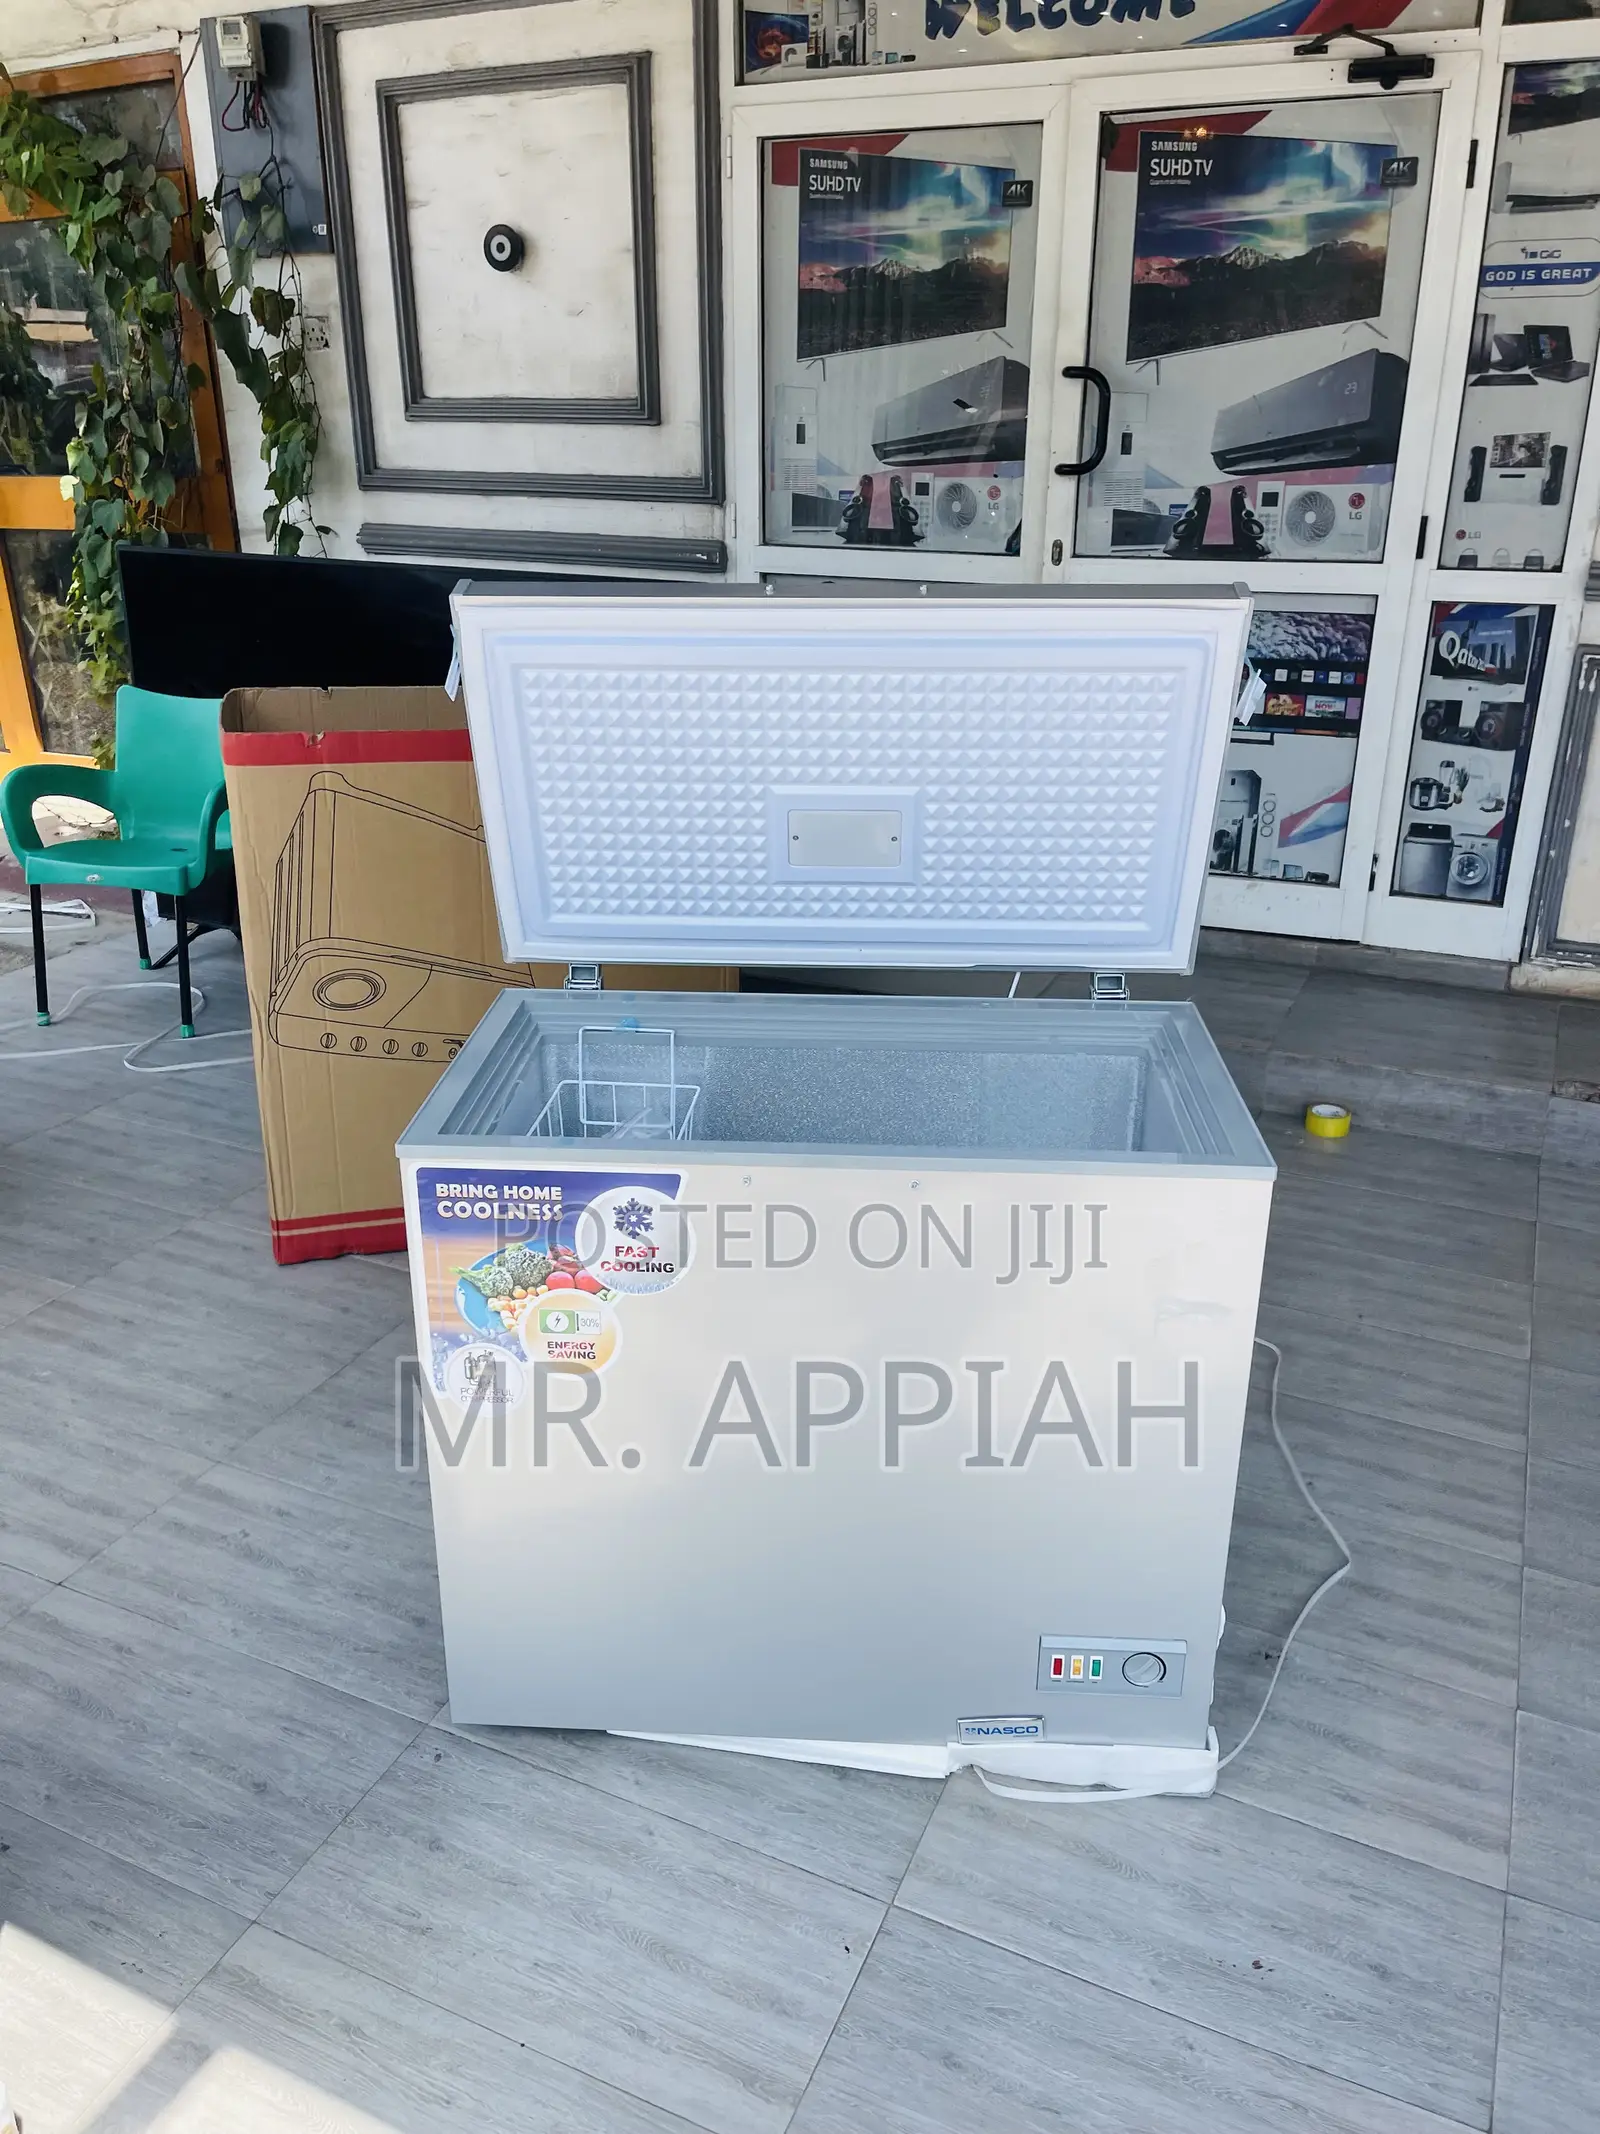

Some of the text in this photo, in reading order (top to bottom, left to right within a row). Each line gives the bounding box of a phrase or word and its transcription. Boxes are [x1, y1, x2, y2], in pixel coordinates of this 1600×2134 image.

[1151, 141, 1198, 152] SAMSUNG
[809, 158, 848, 170] SAMSUNG
[1485, 268, 1593, 282] GOD IS GREAT
[987, 502, 1000, 511] LG
[1348, 510, 1363, 520] LG
[435, 1183, 563, 1201] BRING HOME
[436, 1200, 564, 1221] COOLNESS
[614, 1245, 660, 1258] FAST
[600, 1260, 675, 1274] COOLING
[580, 1317, 600, 1329] 30%
[546, 1340, 597, 1351] ENERGY
[548, 1350, 597, 1360] SAVING
[977, 1725, 1039, 1735] NASCO
